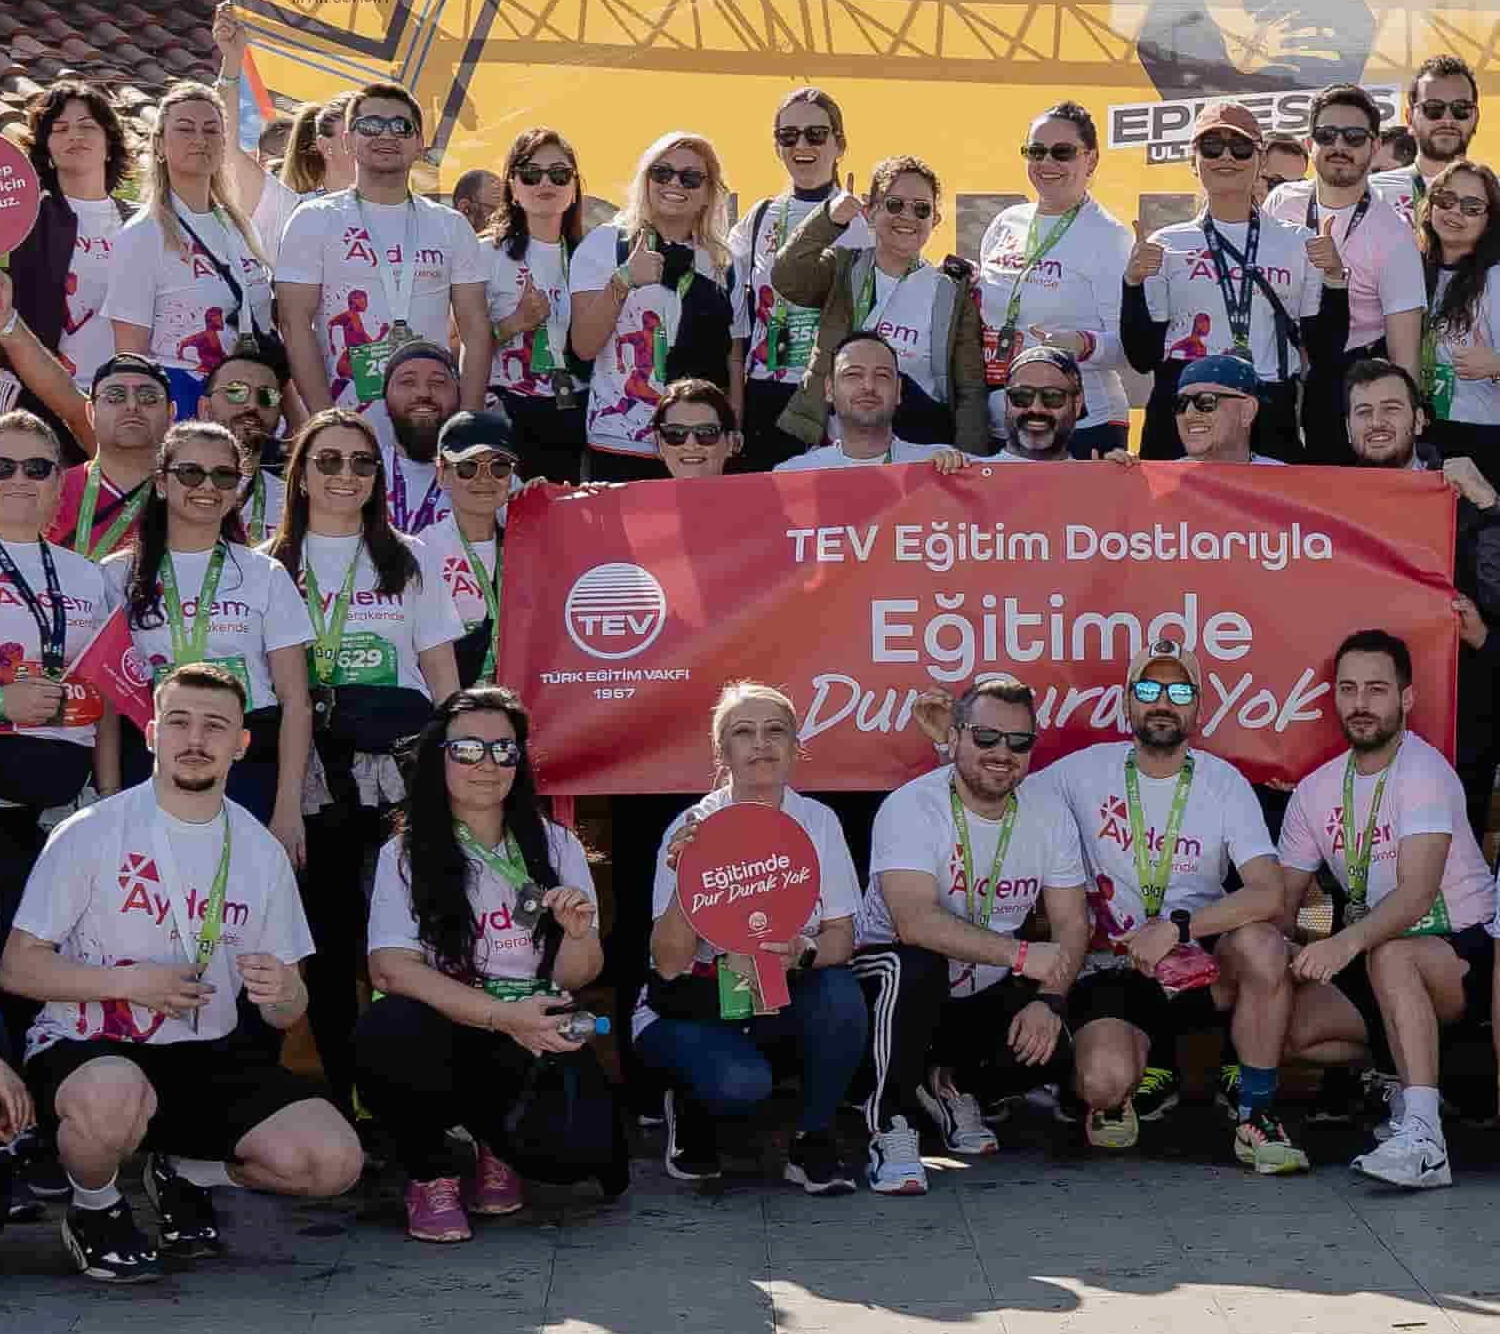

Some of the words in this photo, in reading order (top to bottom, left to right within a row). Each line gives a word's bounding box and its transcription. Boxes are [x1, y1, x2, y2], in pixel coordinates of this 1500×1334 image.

[1113, 89, 1396, 143] EPESS
[0, 177, 27, 193] için
[345, 242, 444, 268] Aydm
[787, 524, 878, 563] TEV
[894, 521, 1049, 572] Eğitim
[1065, 521, 1334, 571] Dostlarıyla
[577, 616, 655, 636] TEV
[870, 592, 1253, 683] Eğitimde
[338, 646, 383, 670] 629
[540, 669, 583, 684] TÜRK
[643, 668, 691, 681] VAKFI
[594, 688, 637, 700] 1967
[1203, 668, 1331, 738] Yok
[701, 853, 790, 891] Eğitimde
[691, 893, 724, 914] Dur
[727, 879, 777, 905] Durak
[782, 867, 811, 887] Yok
